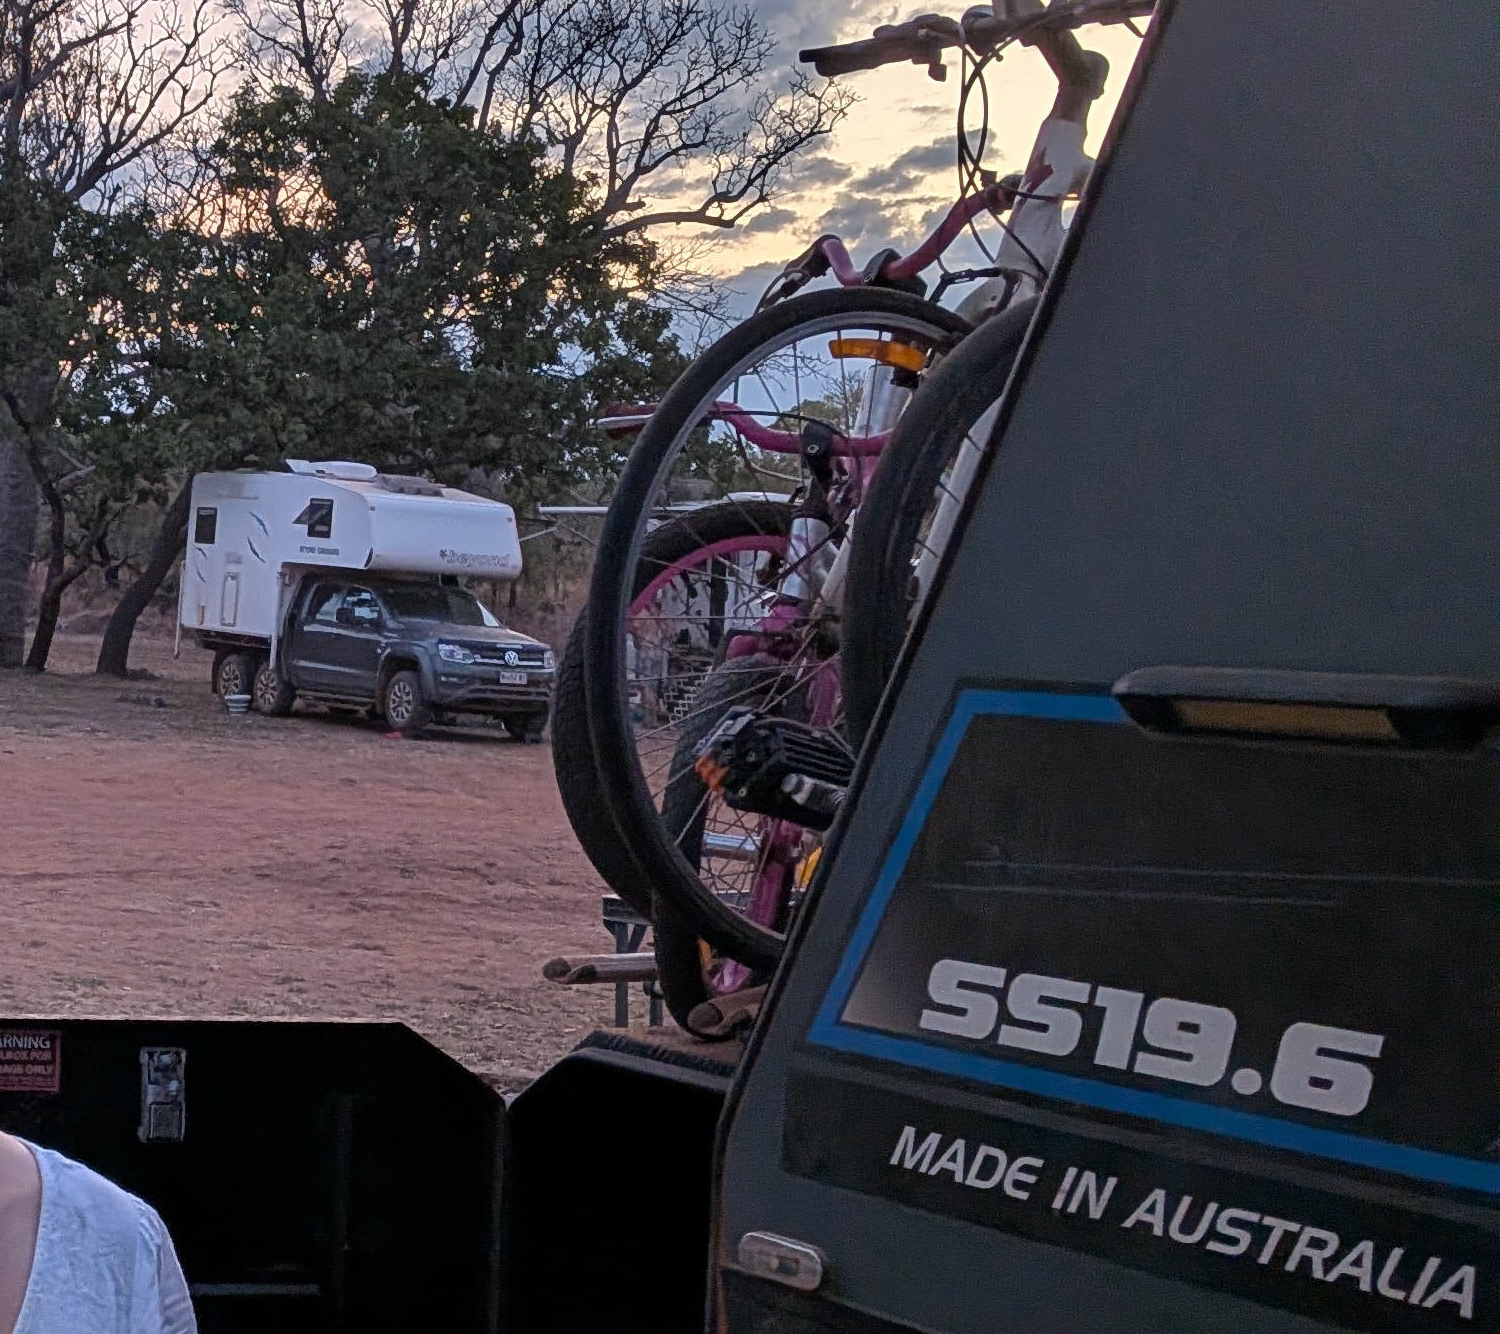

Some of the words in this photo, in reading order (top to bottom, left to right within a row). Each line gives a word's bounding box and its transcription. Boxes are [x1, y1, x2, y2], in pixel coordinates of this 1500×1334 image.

[447, 549, 510, 567] beyond
[25, 1064, 53, 1075] ONLY
[919, 958, 1386, 1117] SS19.6
[889, 1124, 1046, 1201] MADE
[1051, 1166, 1119, 1221] IN
[1121, 1188, 1477, 1320] AUSTRALIA
